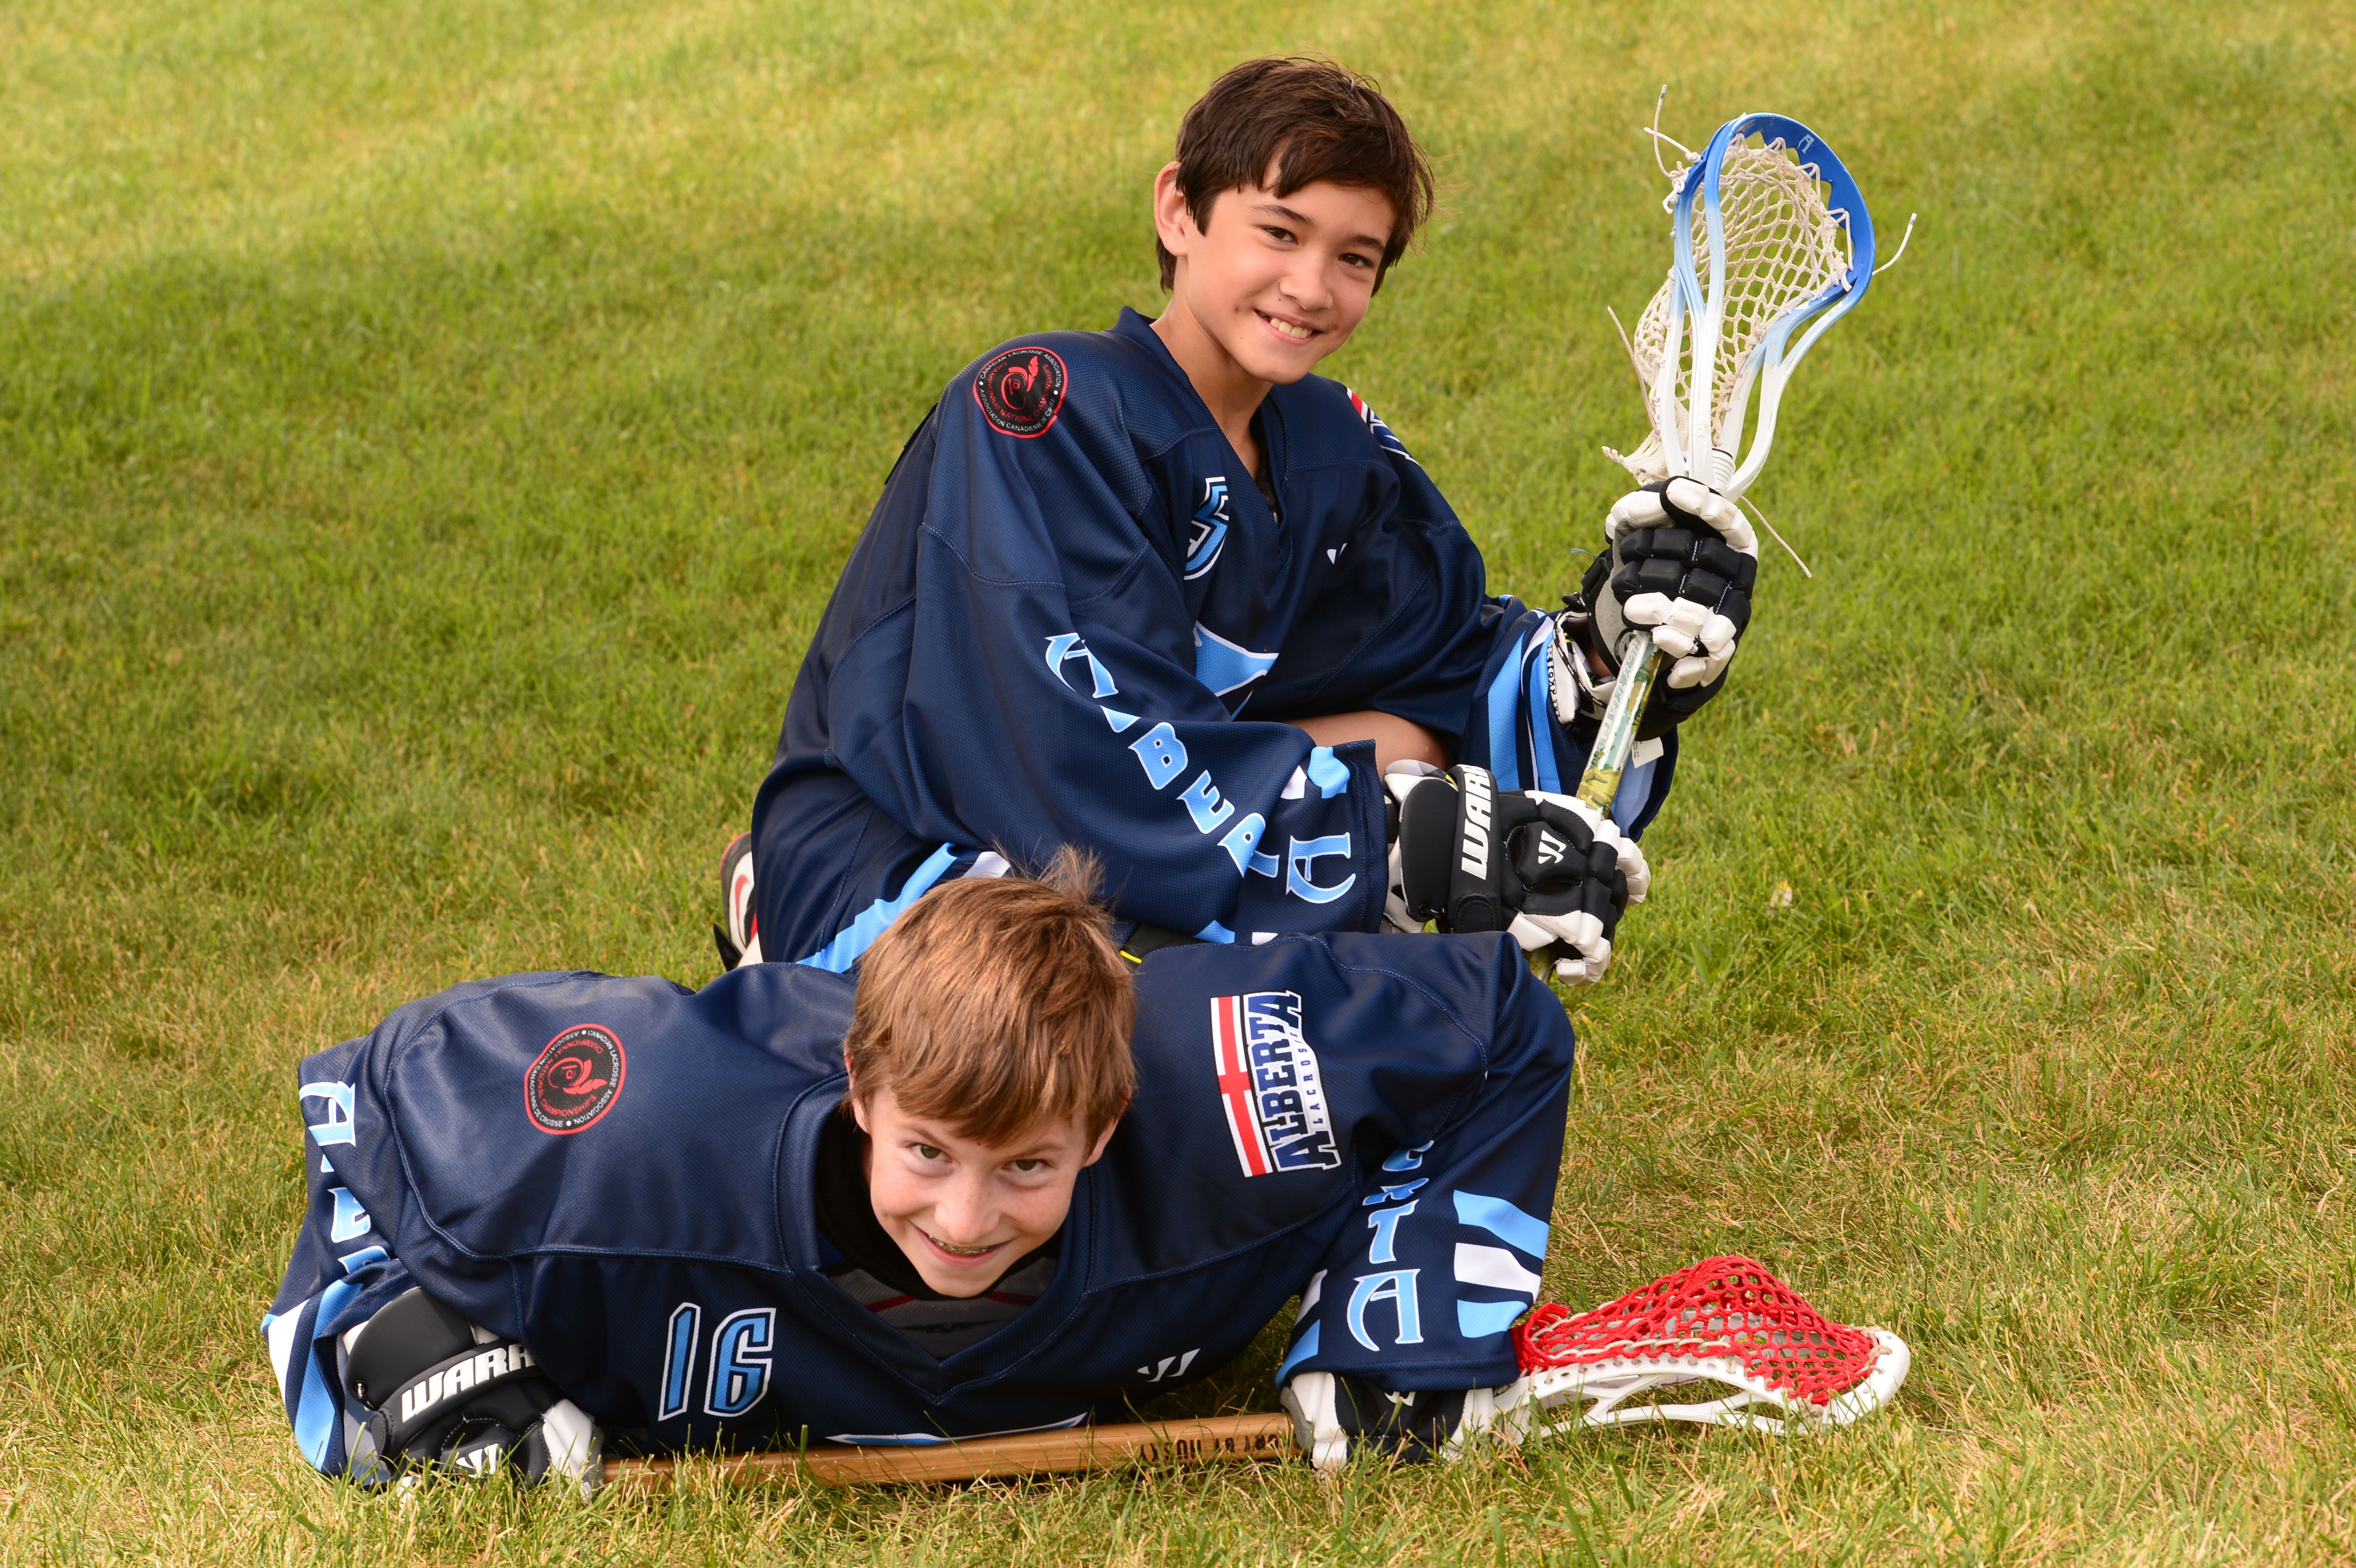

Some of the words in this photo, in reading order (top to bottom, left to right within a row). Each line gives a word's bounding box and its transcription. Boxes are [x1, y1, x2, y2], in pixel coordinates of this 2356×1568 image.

[980, 356, 1006, 379] CANADIAN
[1044, 354, 1061, 388] ASSOCIATION
[980, 389, 1005, 427] ASSOCIATION
[1006, 421, 1043, 432] CANADIENNE
[1041, 415, 1047, 424] DE
[539, 1030, 579, 1065] ASSOCIATION
[588, 1030, 613, 1050] CANADIAN
[609, 1050, 619, 1088] LACROSSE
[1244, 991, 1341, 1170] ALBERTA
[530, 1065, 541, 1110] CANADIENNE
[534, 1108, 542, 1118] DE
[539, 1114, 564, 1128] CROSSE
[541, 1094, 597, 1117] CHAMPIONSHIPS
[574, 1089, 612, 1125] ASSOCIATION
[658, 1302, 776, 1421] 16
